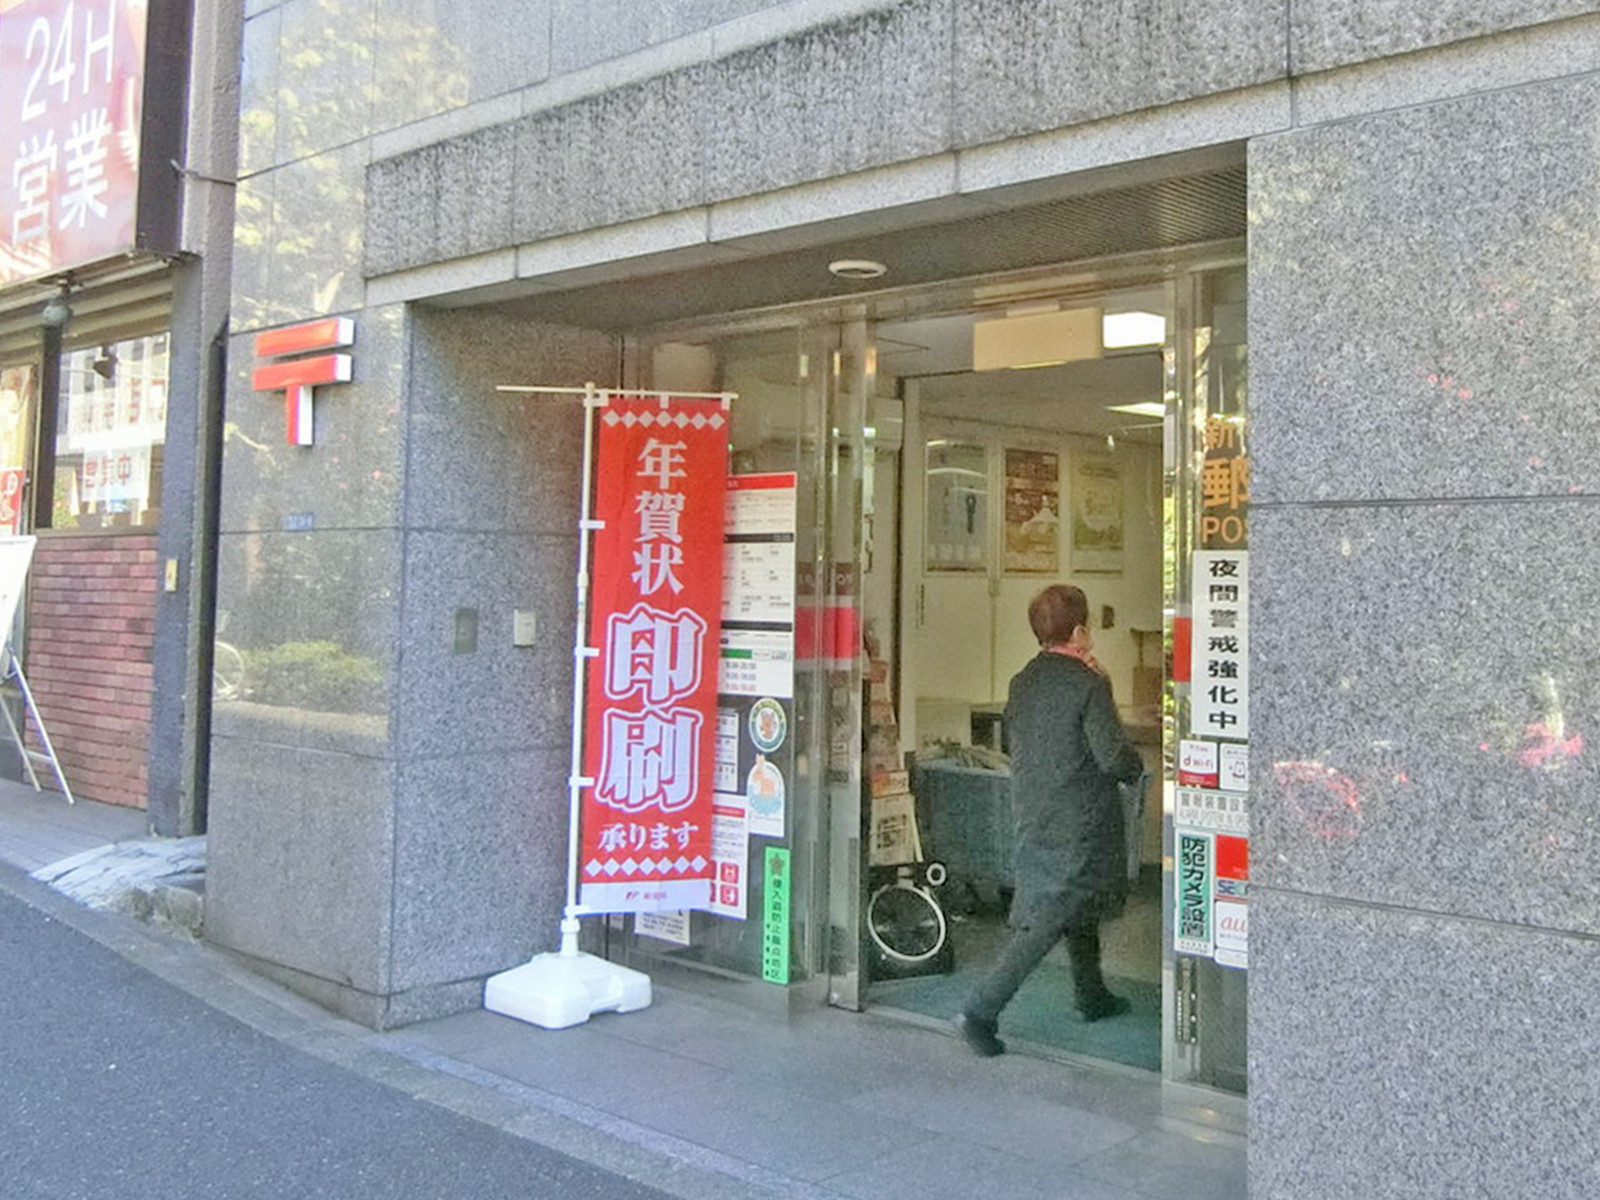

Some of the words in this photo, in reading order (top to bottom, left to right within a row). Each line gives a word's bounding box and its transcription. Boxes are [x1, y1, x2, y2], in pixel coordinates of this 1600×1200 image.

[22, 0, 116, 122] 24H
[12, 106, 113, 249] 営業
[631, 437, 688, 595] 年賀状
[1202, 515, 1248, 544] PO
[1208, 559, 1239, 729] 夜間警戒強化中
[595, 602, 707, 812] 印刷
[597, 821, 699, 852] 承ります
[1217, 879, 1249, 896] SEC
[1220, 916, 1247, 933] au
